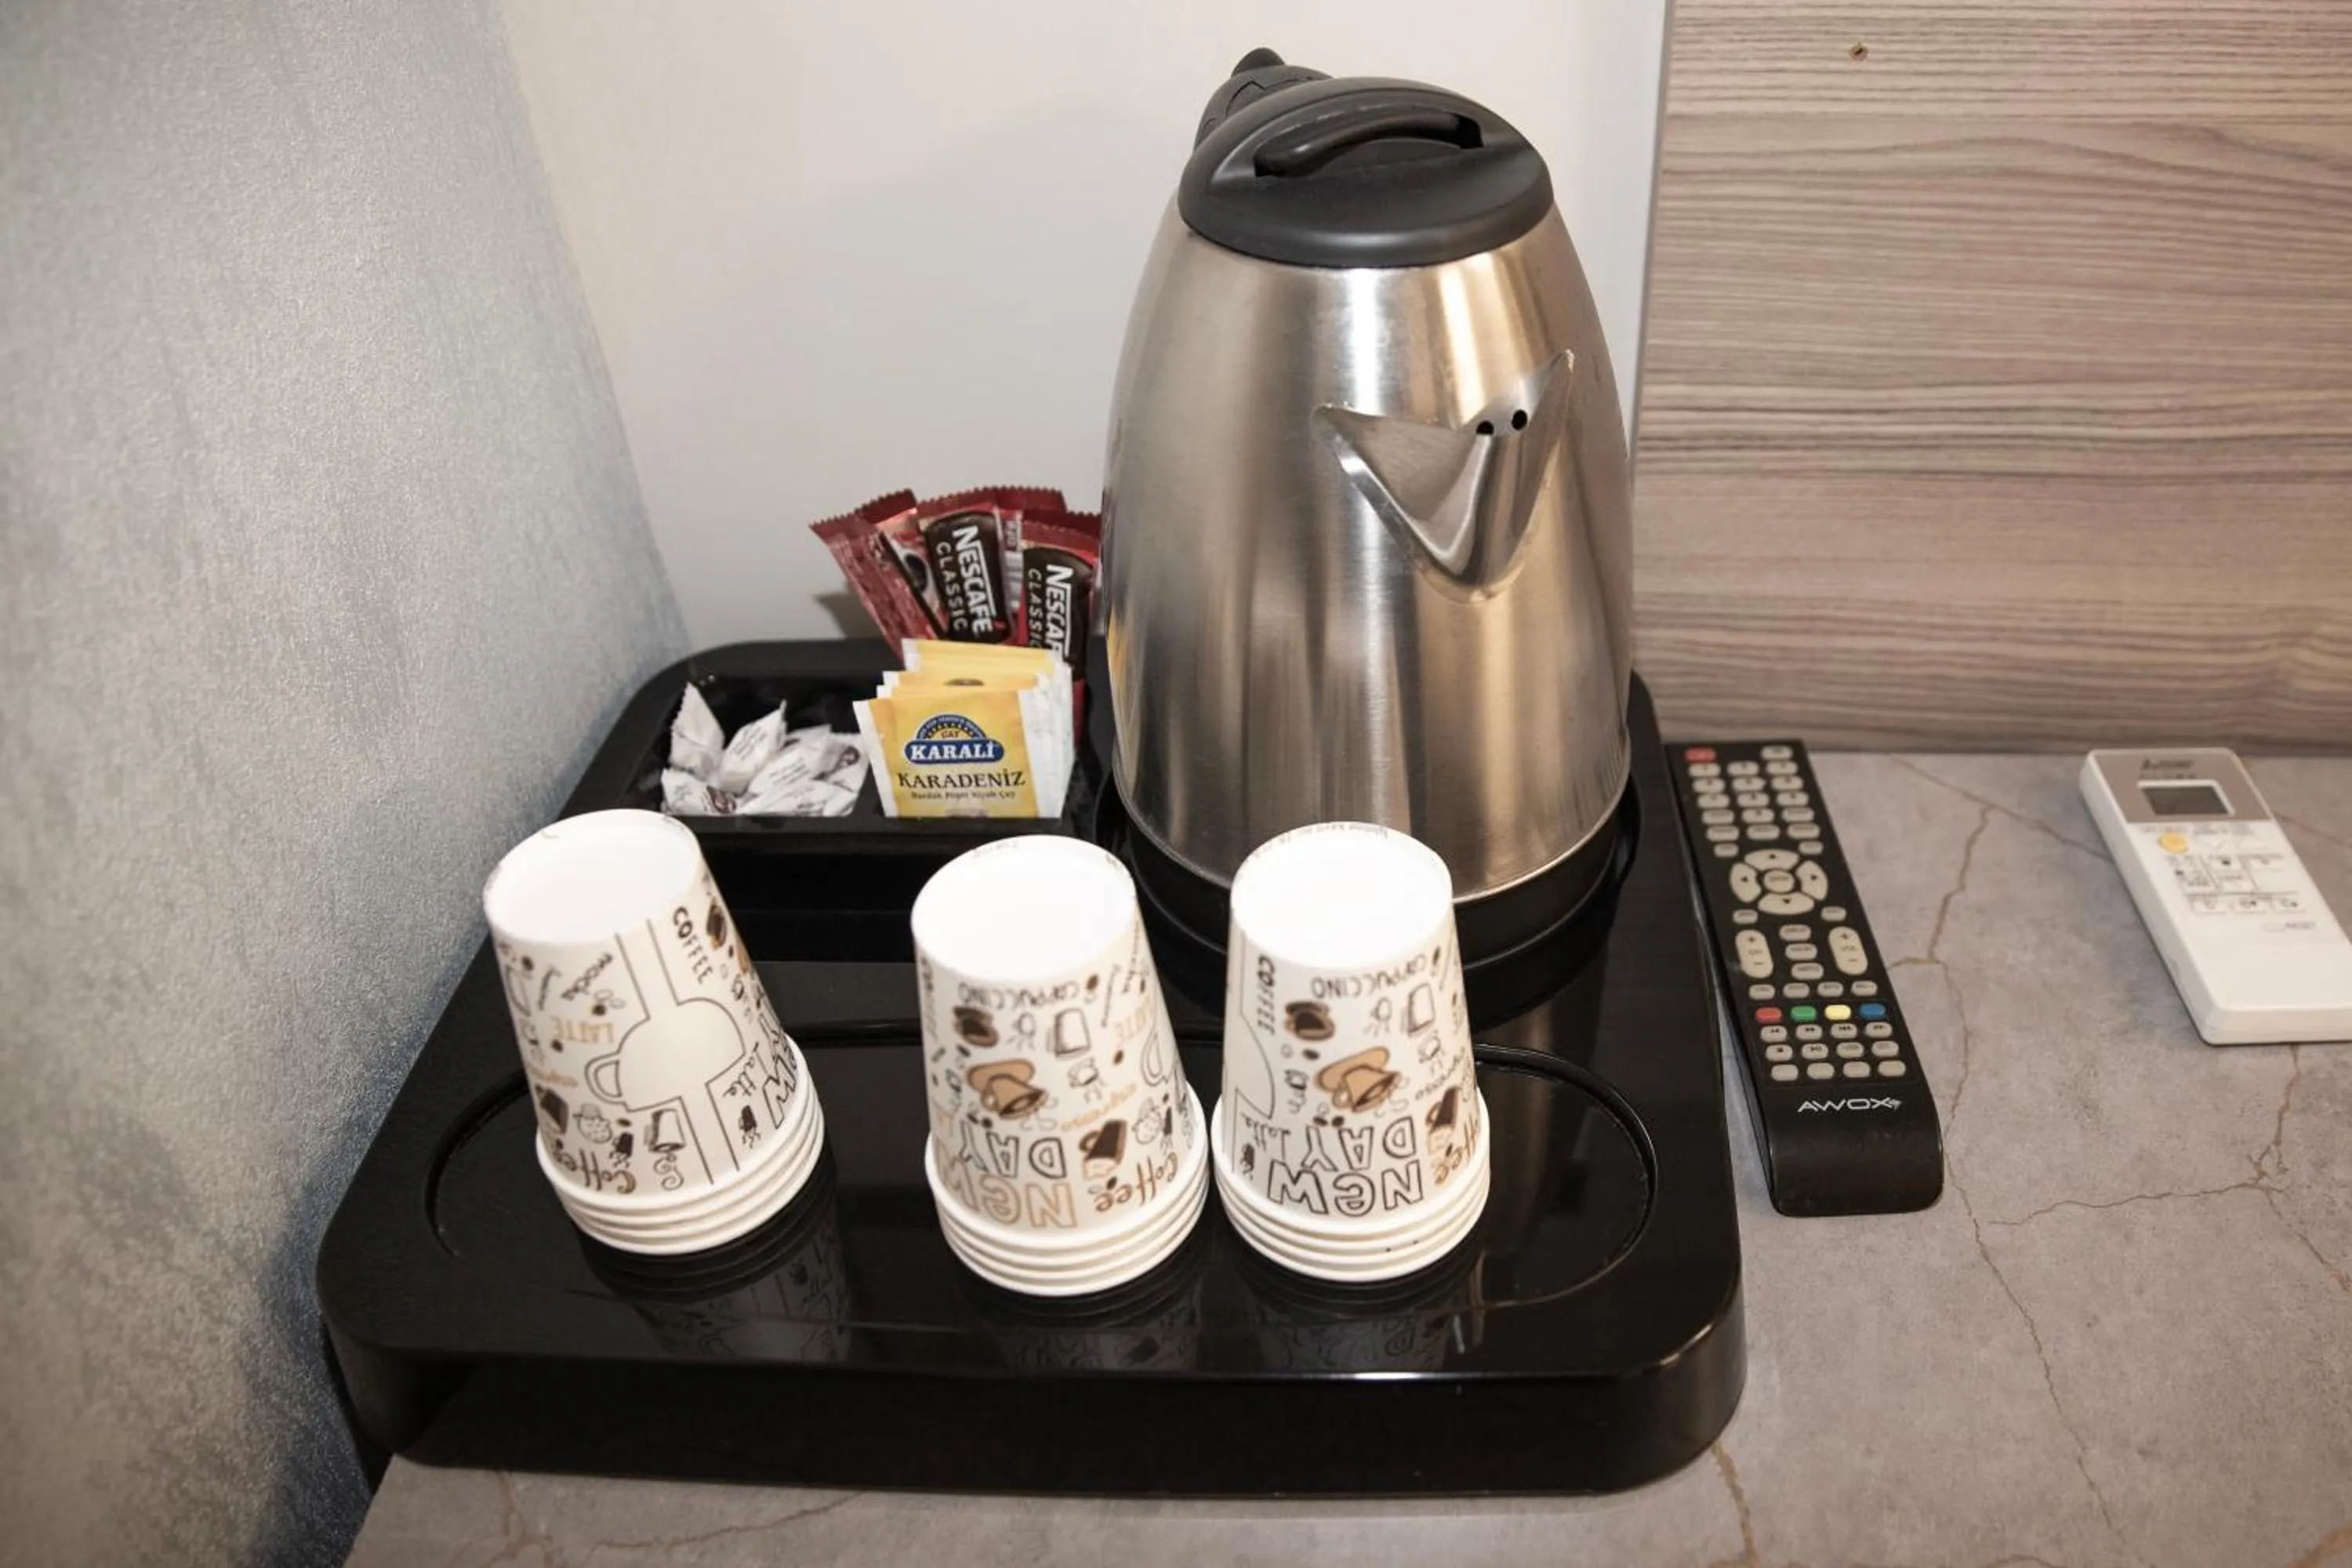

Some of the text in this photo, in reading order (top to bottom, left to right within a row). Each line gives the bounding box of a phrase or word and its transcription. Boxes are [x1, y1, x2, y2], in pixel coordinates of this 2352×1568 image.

[935, 541, 968, 632] CLASSIC
[1797, 1098, 1897, 1113] AWOX
[958, 1118, 1068, 1181] DAY
[1300, 1116, 1417, 1173] DAY
